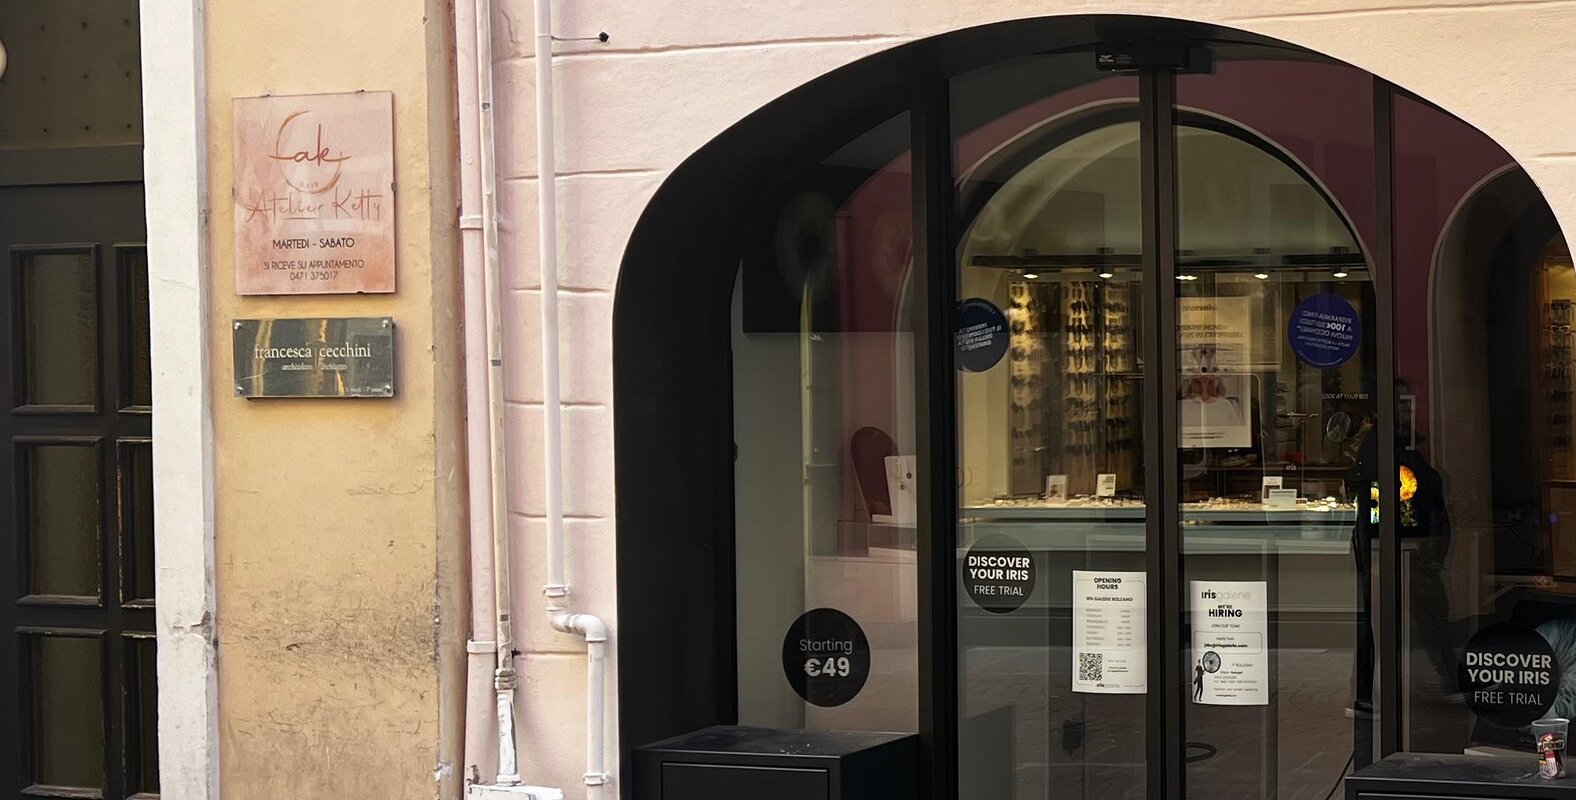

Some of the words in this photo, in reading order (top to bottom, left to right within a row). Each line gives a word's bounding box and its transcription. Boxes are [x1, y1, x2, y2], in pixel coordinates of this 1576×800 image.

[244, 188, 324, 223] Atelier
[332, 187, 382, 221] Ketty
[319, 237, 355, 248] SABATO
[271, 261, 296, 270] RICEVE
[298, 261, 306, 269] SU
[308, 259, 365, 269] APPUNTAMENTO
[290, 271, 307, 281] 0471
[311, 271, 338, 280] 375017
[255, 343, 312, 358] francesca
[319, 342, 371, 358] cecchini
[968, 556, 1030, 568] DISCOVER
[970, 568, 1004, 580] YOUR
[1006, 569, 1029, 581] IRIS
[974, 585, 996, 595] FREE
[998, 586, 1024, 596] TRIAL
[1208, 609, 1243, 617] HIRING
[799, 639, 853, 655] Starting
[804, 656, 850, 677] €49
[1466, 652, 1552, 669] DISCOVER
[1467, 669, 1514, 684] YOUR
[1519, 671, 1550, 685] IRIS
[1474, 691, 1504, 704] FREE
[1508, 692, 1543, 706] TRIAL
